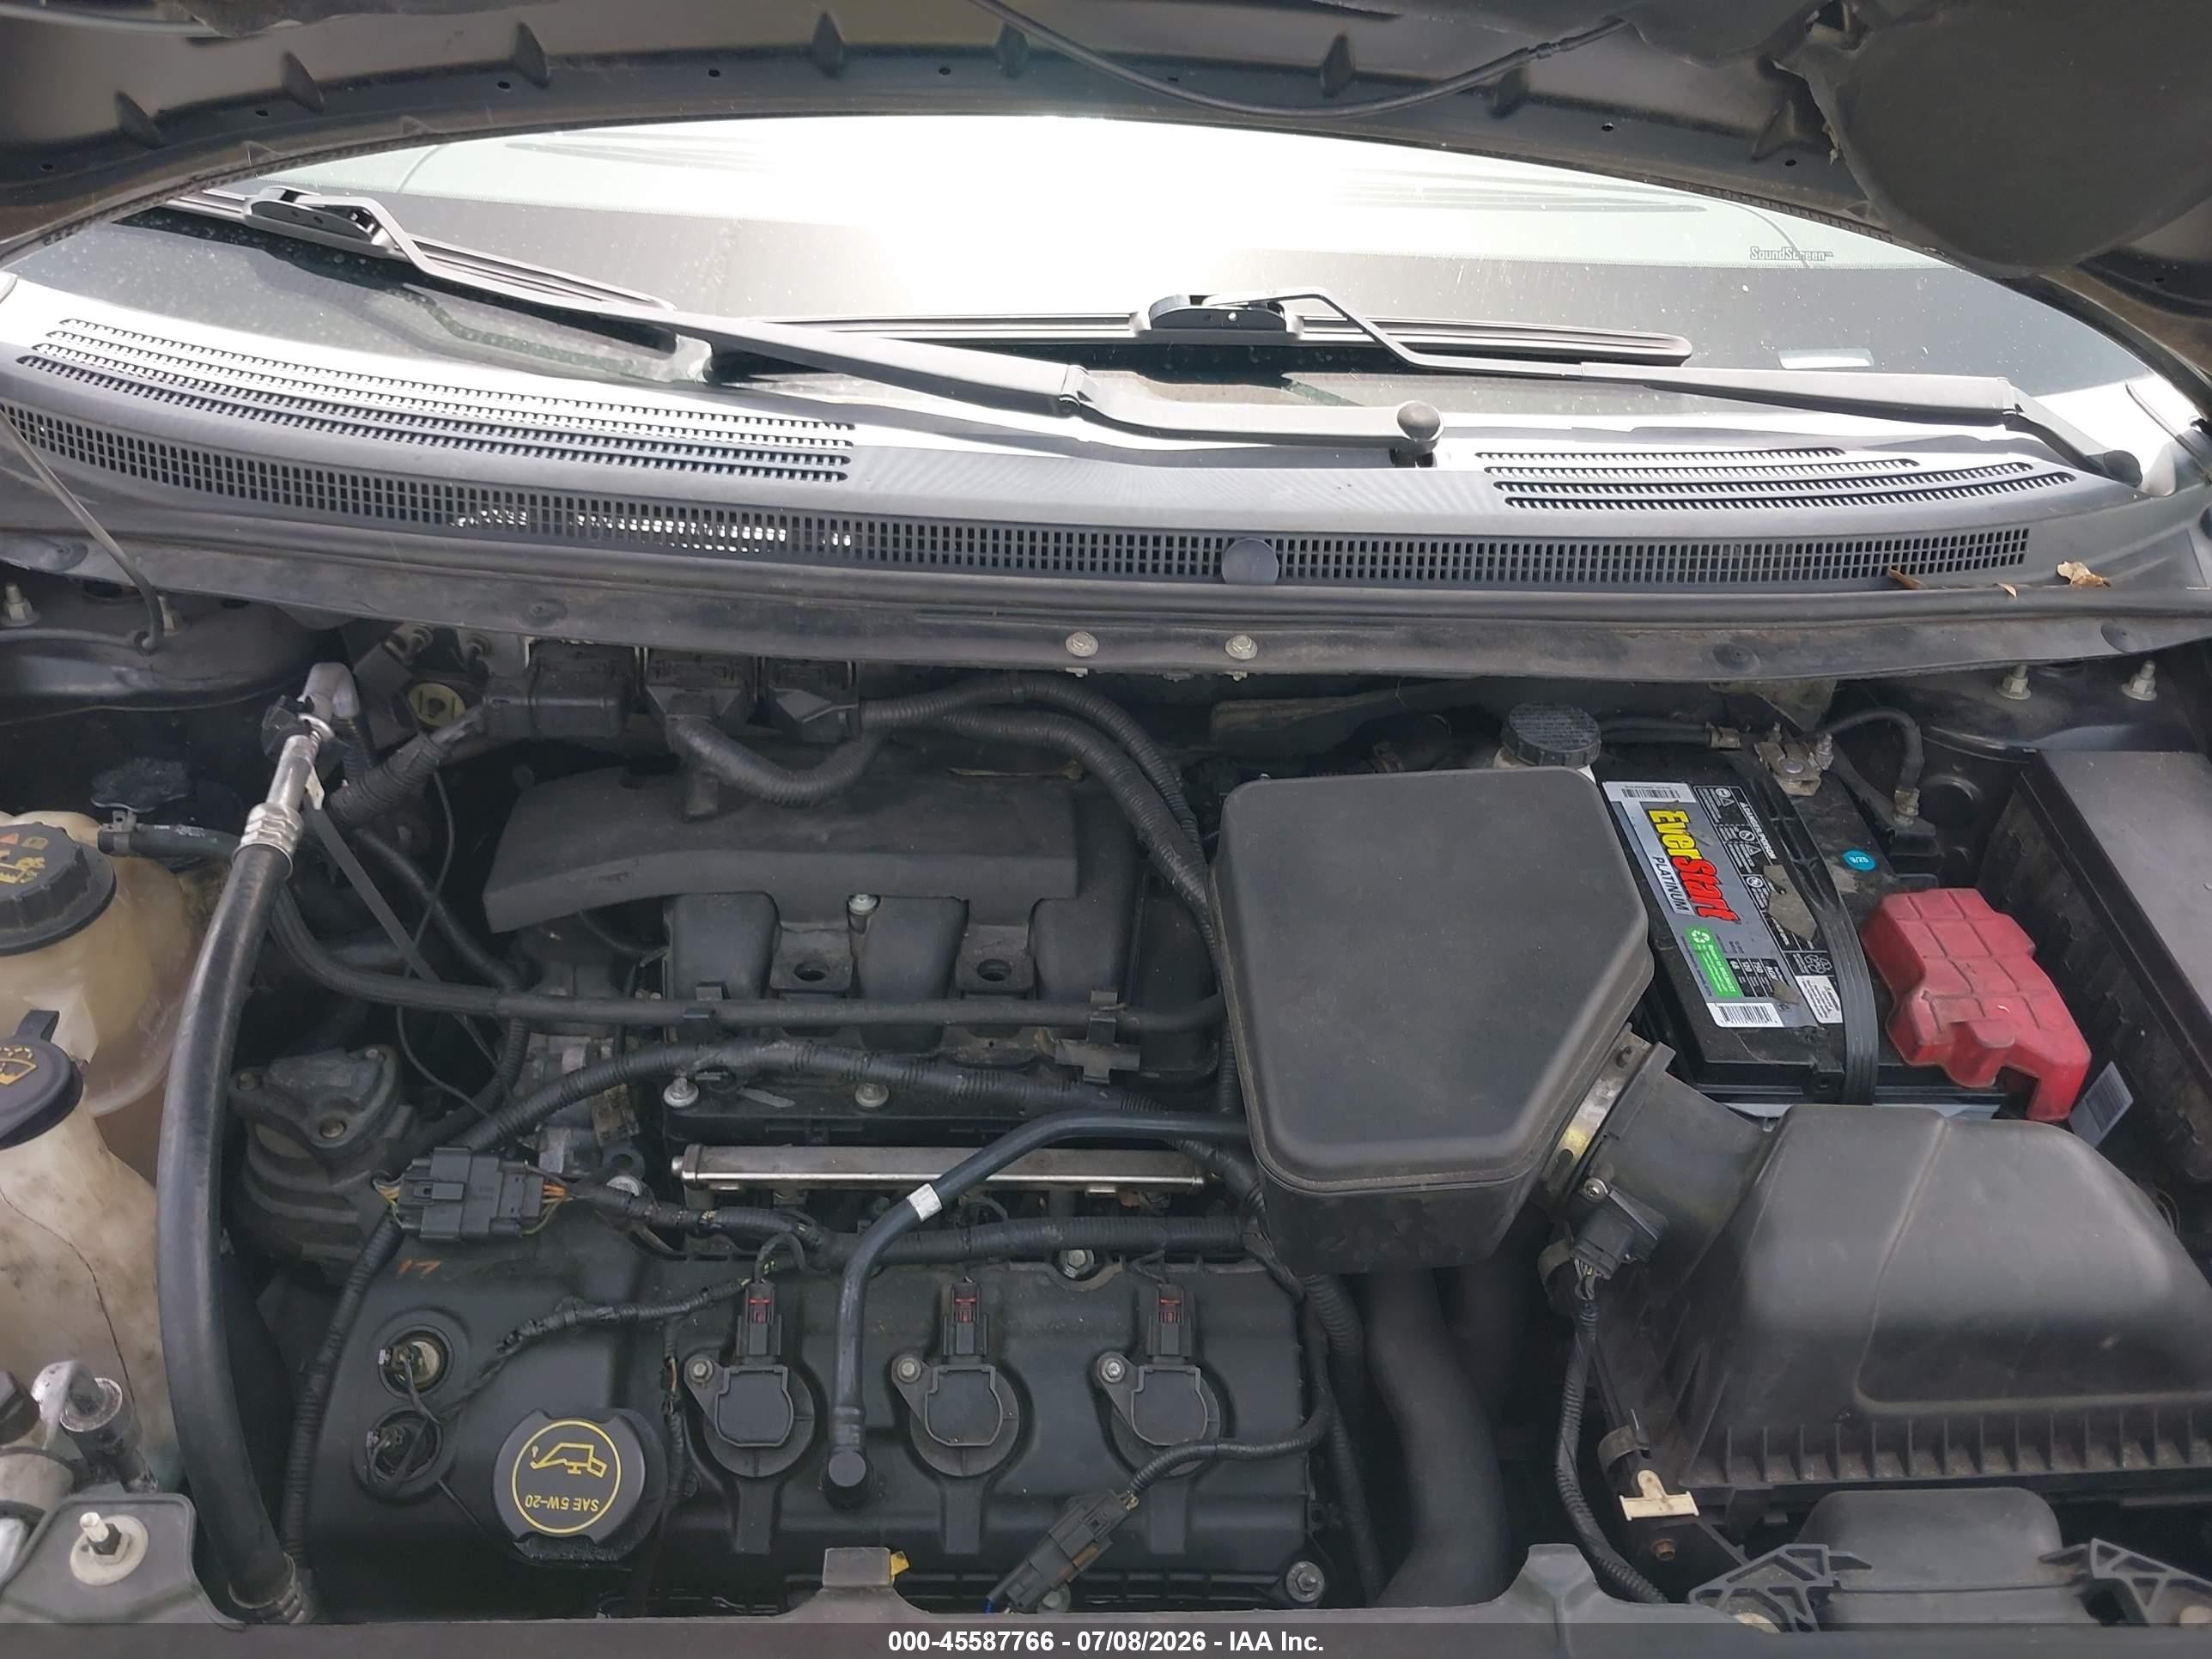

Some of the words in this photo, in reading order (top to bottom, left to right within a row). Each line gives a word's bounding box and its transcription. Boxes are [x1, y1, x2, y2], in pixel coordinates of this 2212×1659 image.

[1648, 809, 1741, 921] EverStart
[1652, 856, 1691, 911] PLATINUM
[525, 1494, 570, 1511] 5W-20
[573, 1498, 599, 1512] SAE
